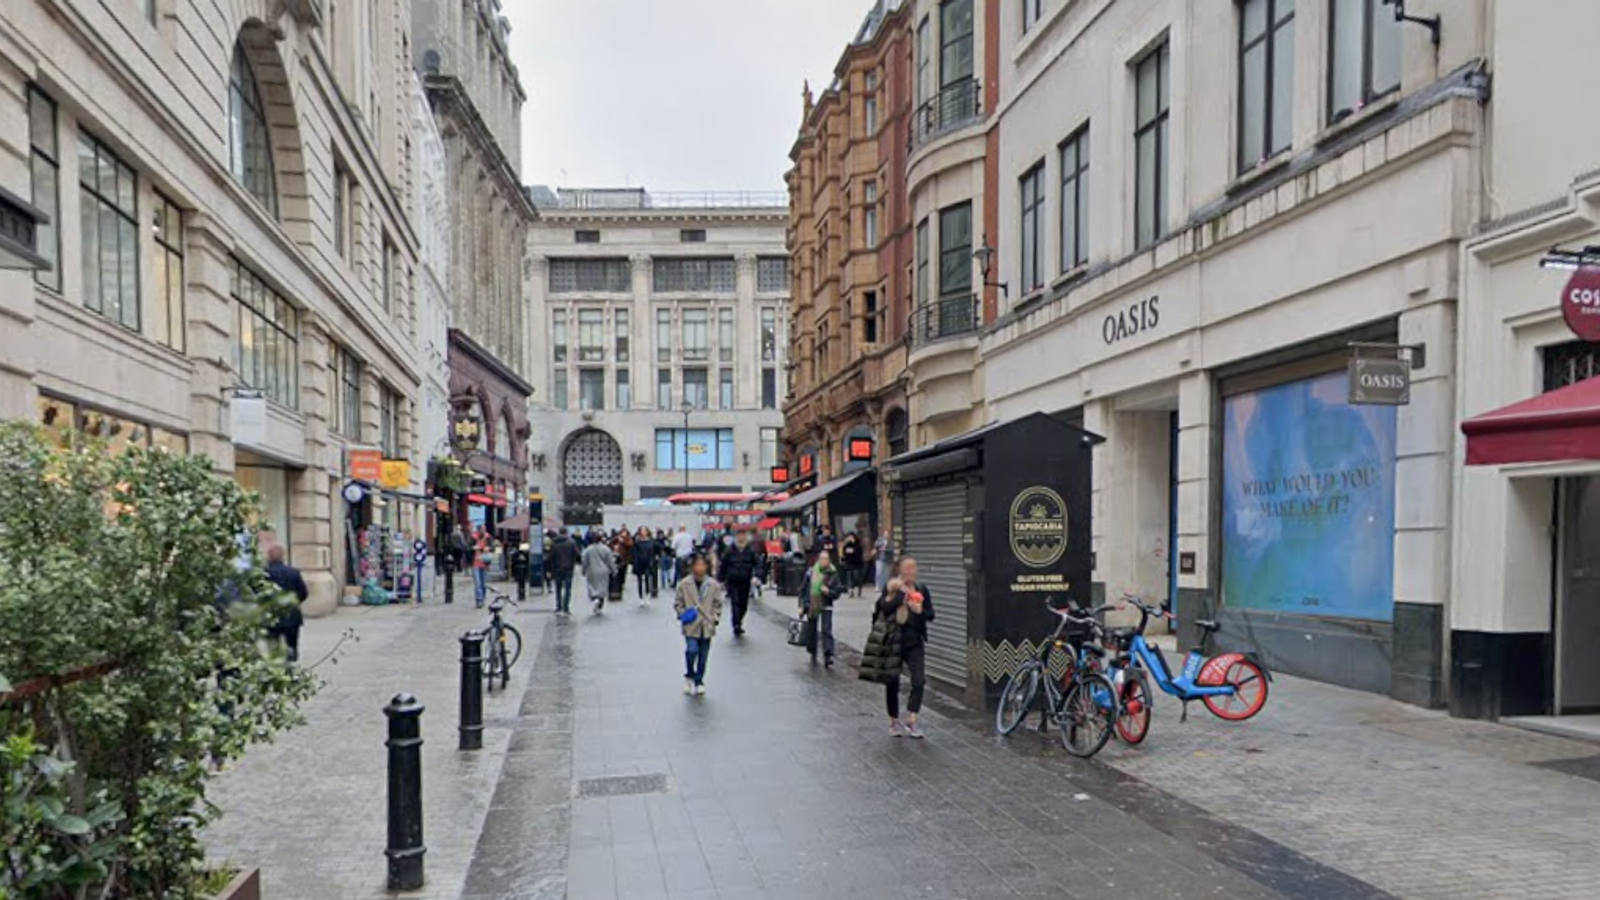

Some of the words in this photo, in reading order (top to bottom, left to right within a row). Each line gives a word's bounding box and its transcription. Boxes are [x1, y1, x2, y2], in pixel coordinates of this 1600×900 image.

[1103, 295, 1159, 345] OASIS
[1360, 373, 1405, 389] OASIS
[1242, 481, 1276, 495] WHAT
[1283, 473, 1334, 492] WOULD
[1341, 468, 1375, 488] YOU
[1260, 500, 1298, 517] MAKE
[1302, 498, 1321, 514] OF
[1328, 495, 1349, 513] IT?
[1010, 583, 1036, 592] VEGAN
[1036, 583, 1070, 592] FRIENDLY
[1017, 574, 1045, 583] GLUTEN
[1046, 574, 1064, 582] FREE
